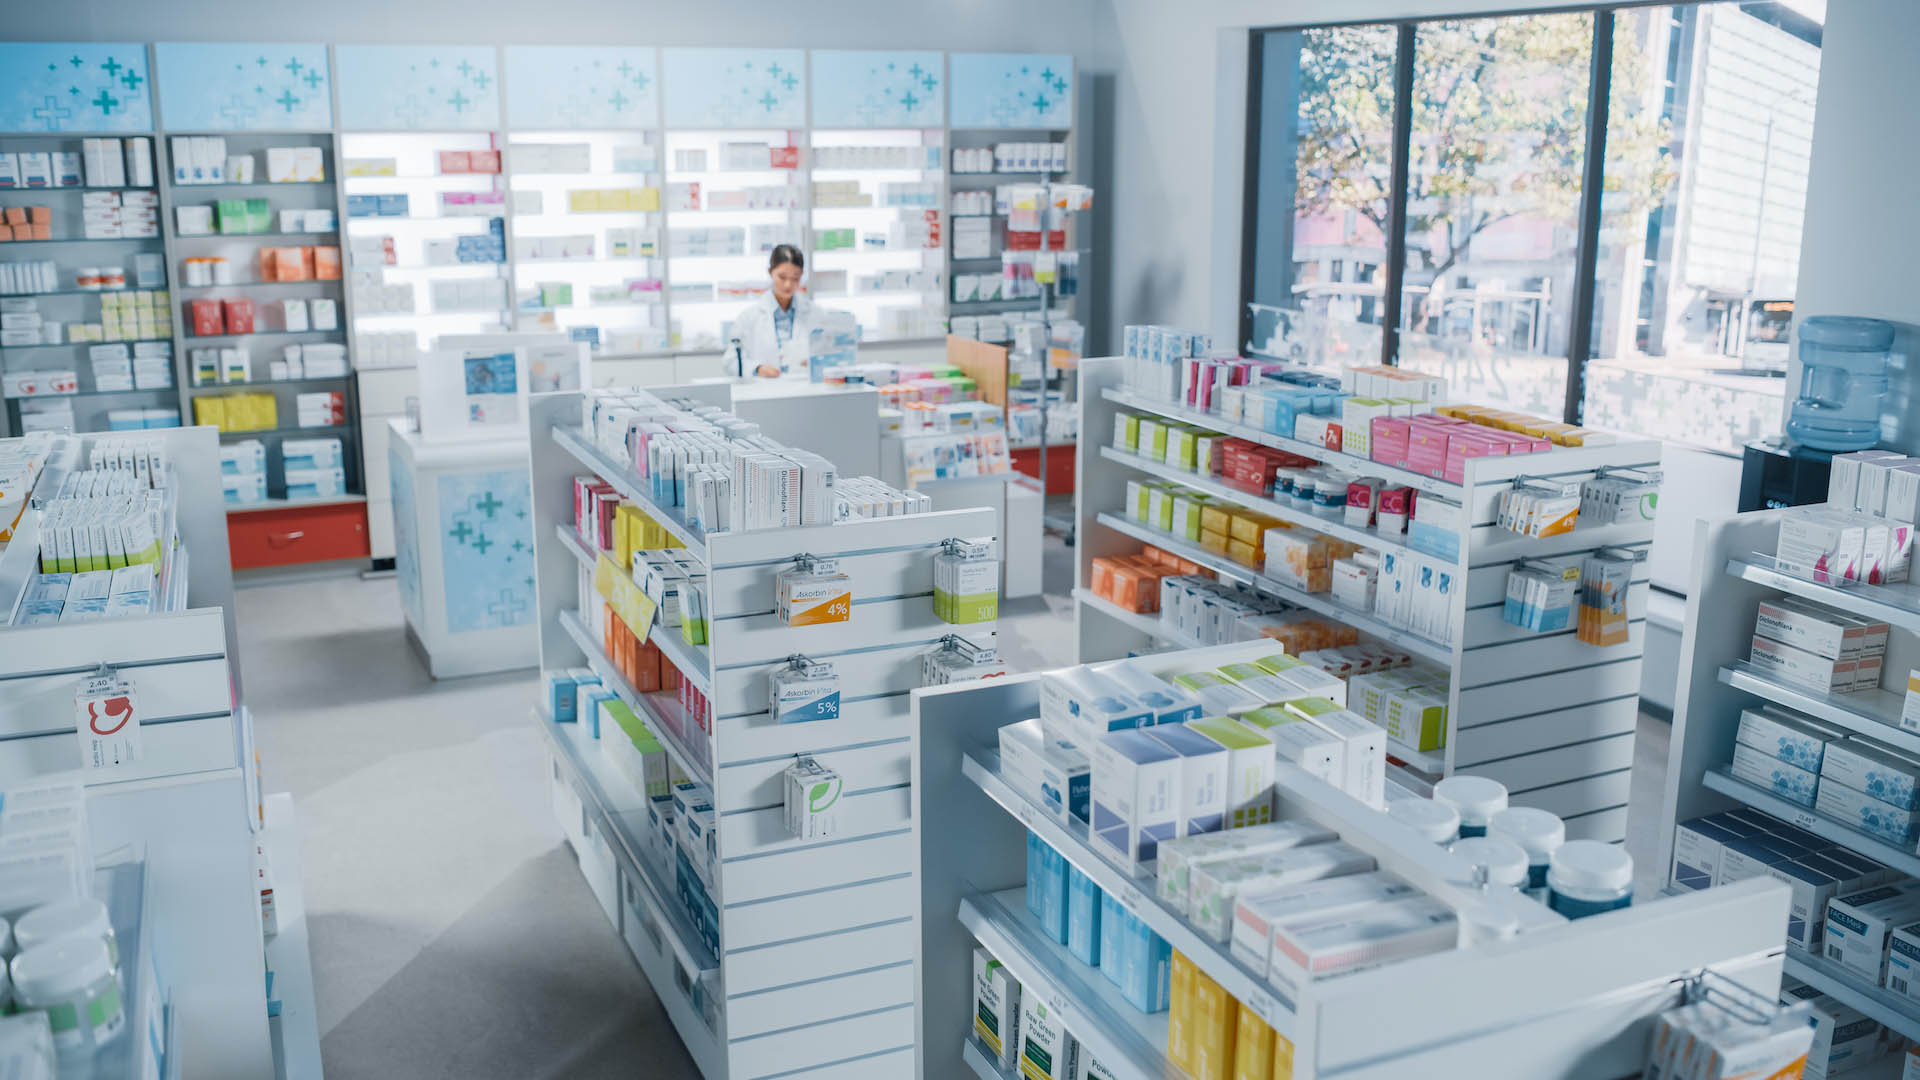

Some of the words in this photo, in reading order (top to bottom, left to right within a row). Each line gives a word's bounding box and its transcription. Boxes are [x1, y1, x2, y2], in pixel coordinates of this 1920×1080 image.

[827, 603, 847, 616] 4%
[89, 679, 108, 688] 2.40
[784, 688, 816, 698] Askorbin
[816, 701, 838, 715] 5%
[1025, 1009, 1038, 1025] Raw
[1038, 1021, 1056, 1040] Green
[1028, 1022, 1051, 1047] Powder
